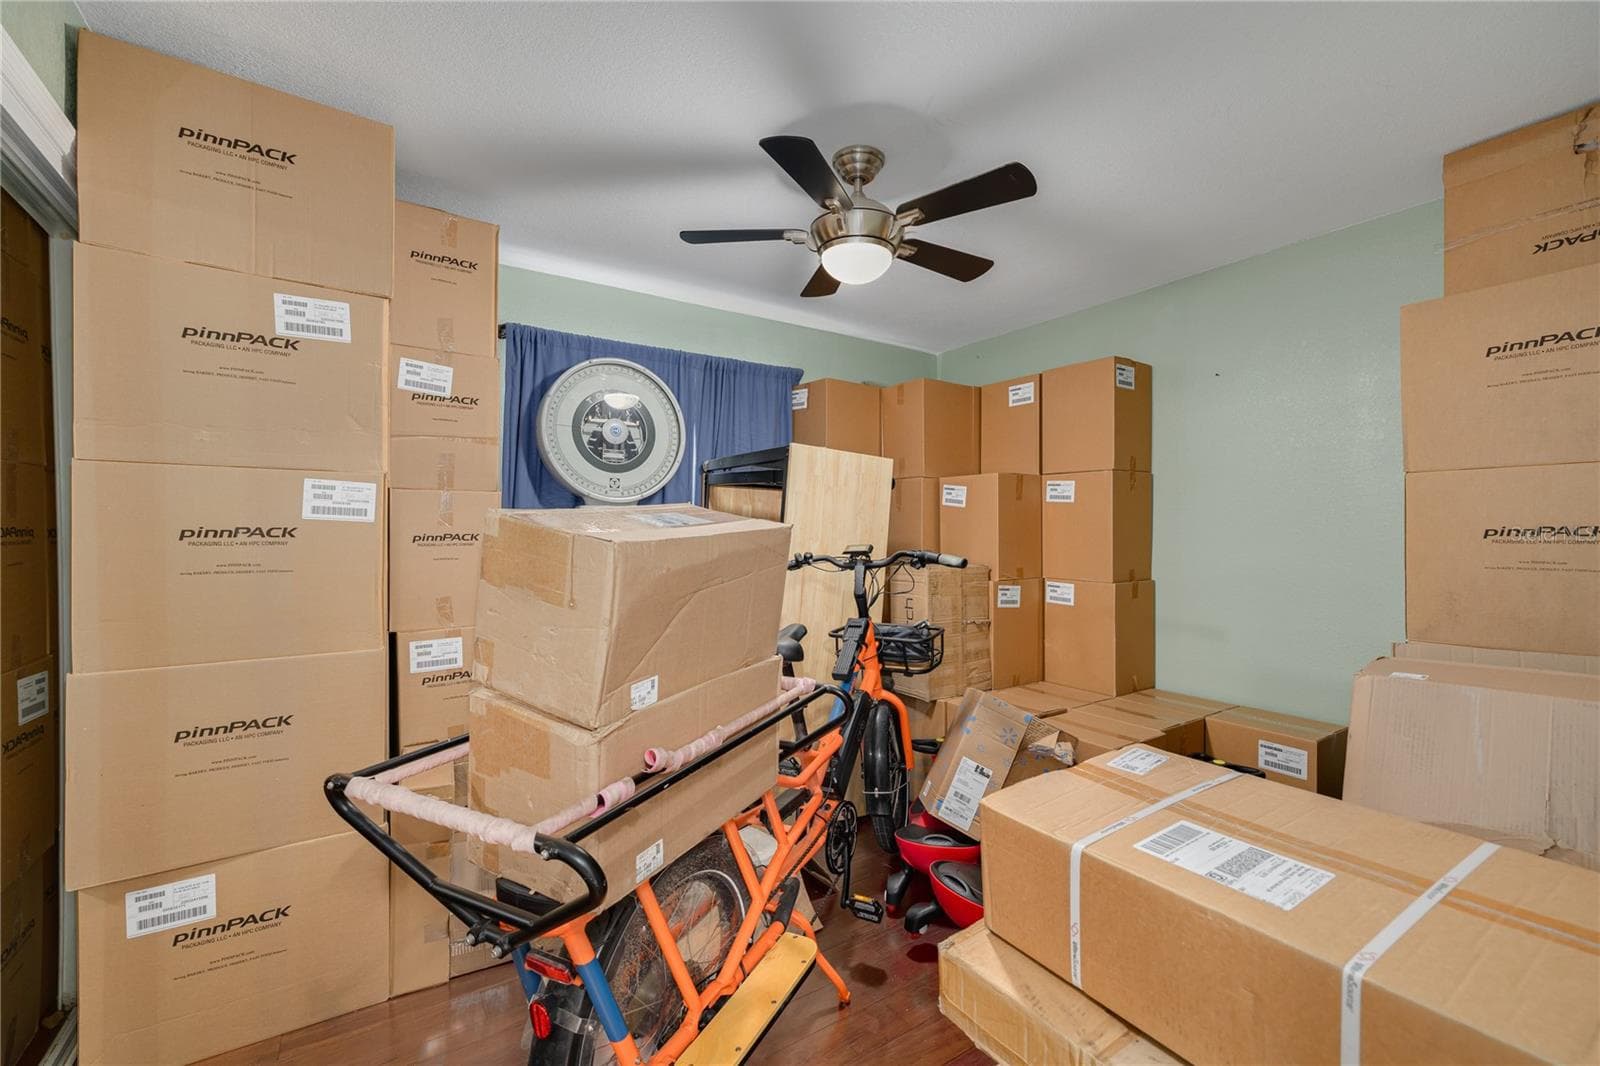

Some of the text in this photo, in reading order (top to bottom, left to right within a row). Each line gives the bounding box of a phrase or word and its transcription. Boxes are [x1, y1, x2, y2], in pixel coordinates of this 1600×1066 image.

[178, 127, 297, 165] pinnPACK
[1532, 228, 1600, 255] PACK
[410, 250, 479, 270] pinnPACK
[181, 326, 301, 351] pinnPACK
[178, 526, 298, 541] pinnPACK
[412, 533, 480, 543] pinnPACK
[421, 670, 473, 686] pinnPA
[174, 714, 294, 744] pinnPACK
[172, 905, 292, 947] pinnPACK
